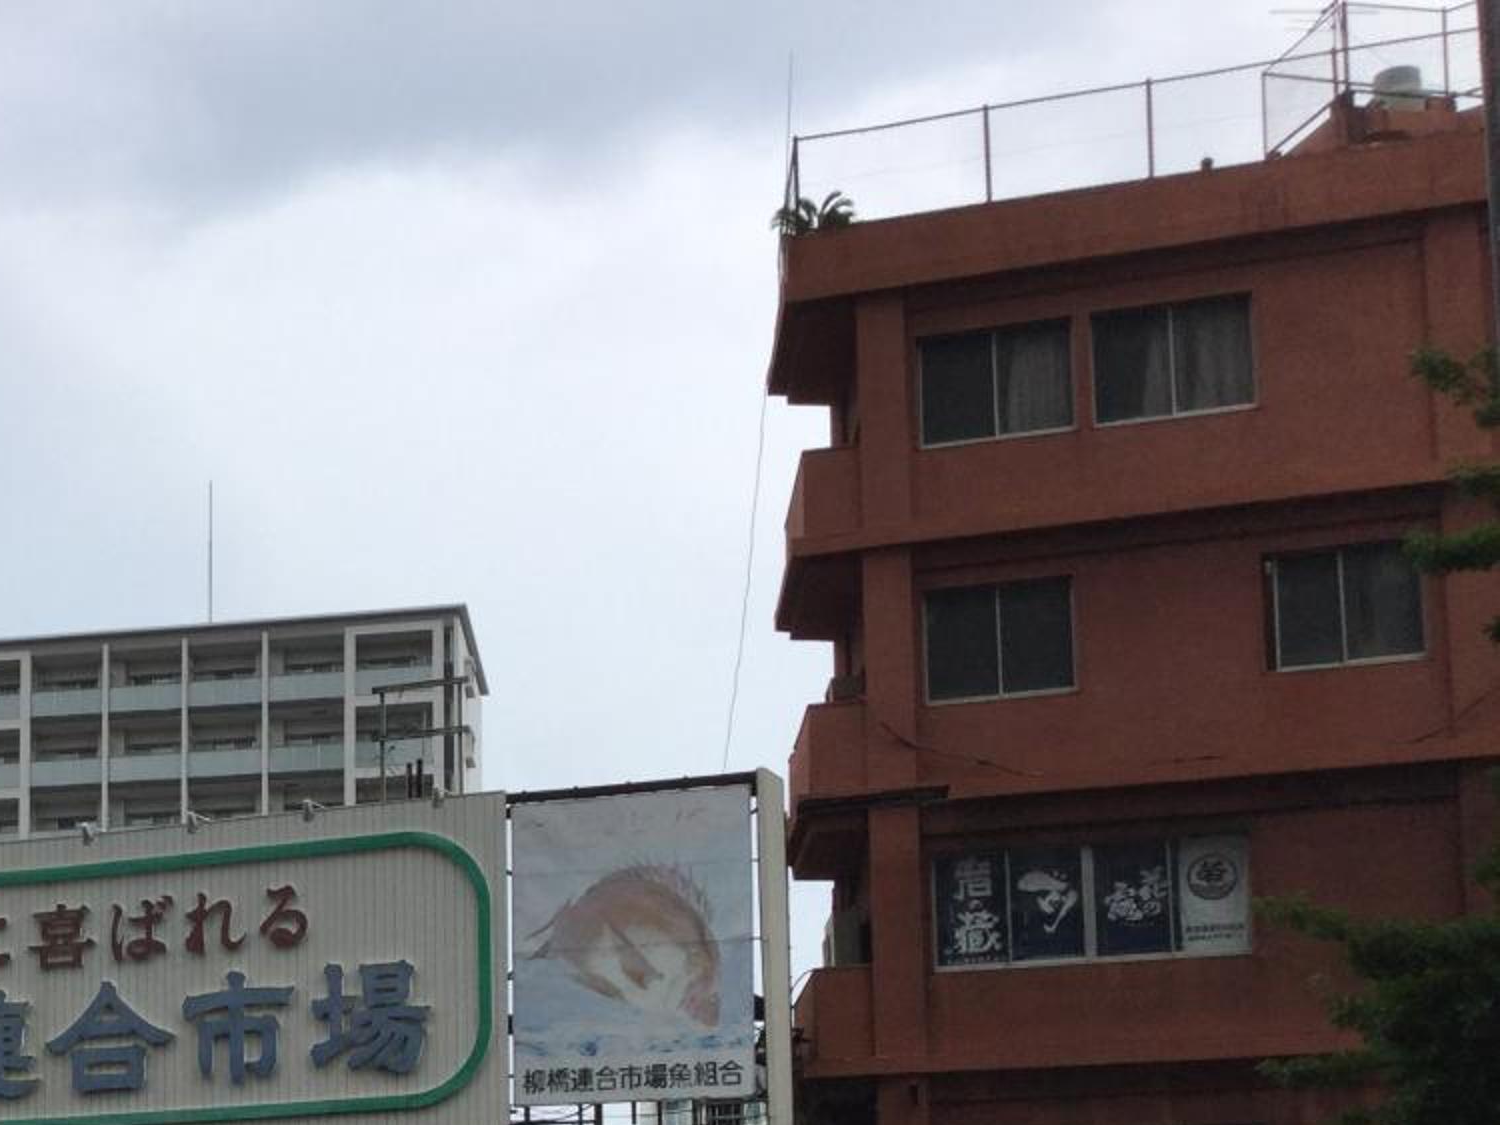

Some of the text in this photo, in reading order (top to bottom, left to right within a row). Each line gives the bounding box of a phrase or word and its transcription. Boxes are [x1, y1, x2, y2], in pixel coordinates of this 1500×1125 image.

[523, 1060, 744, 1094] 柳橋連合市場魚組合
